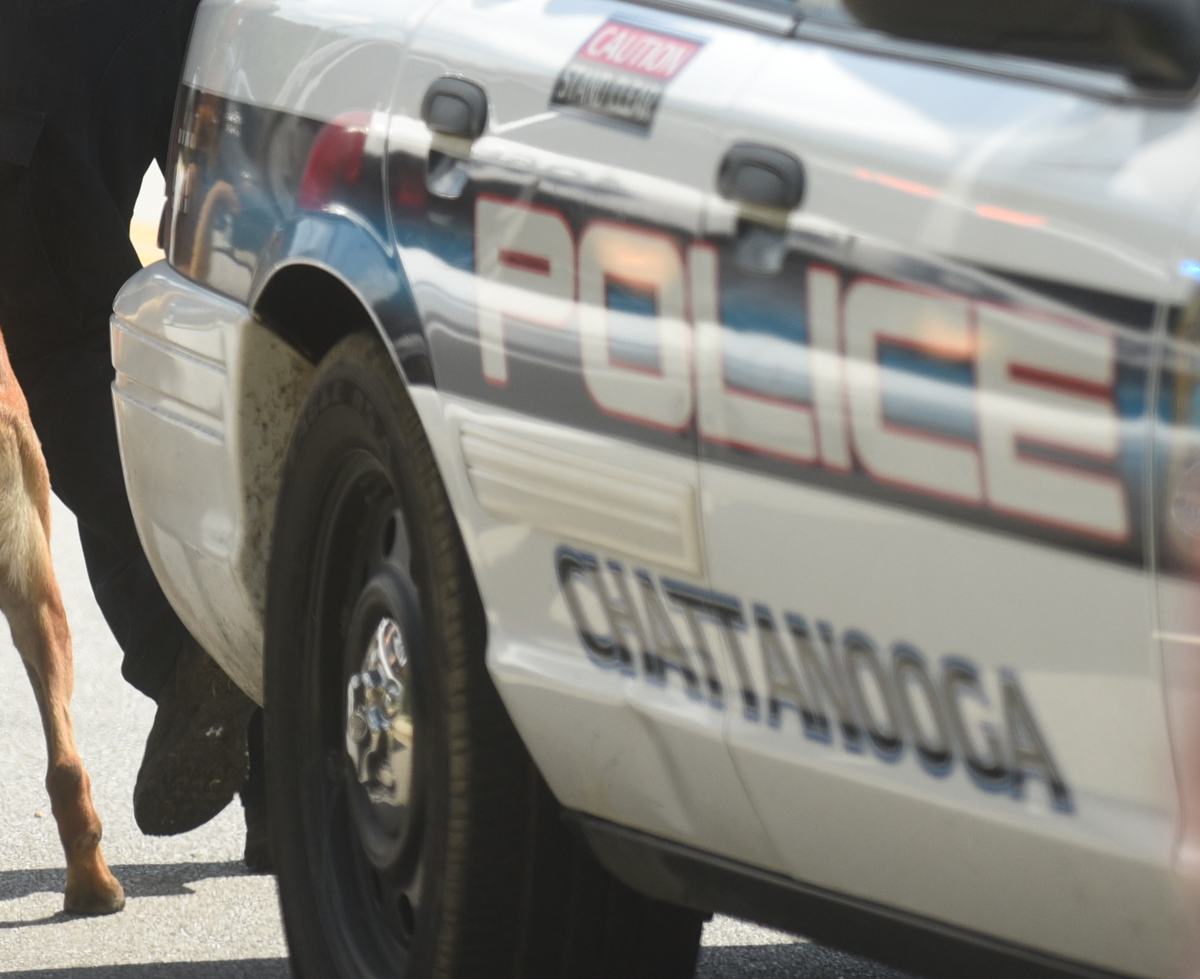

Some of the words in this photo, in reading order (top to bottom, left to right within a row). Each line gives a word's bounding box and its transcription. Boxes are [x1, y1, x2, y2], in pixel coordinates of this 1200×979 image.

[587, 26, 687, 76] CAUTION
[474, 194, 1132, 543] POLICE
[555, 546, 1076, 814] CHATTANOOGA
